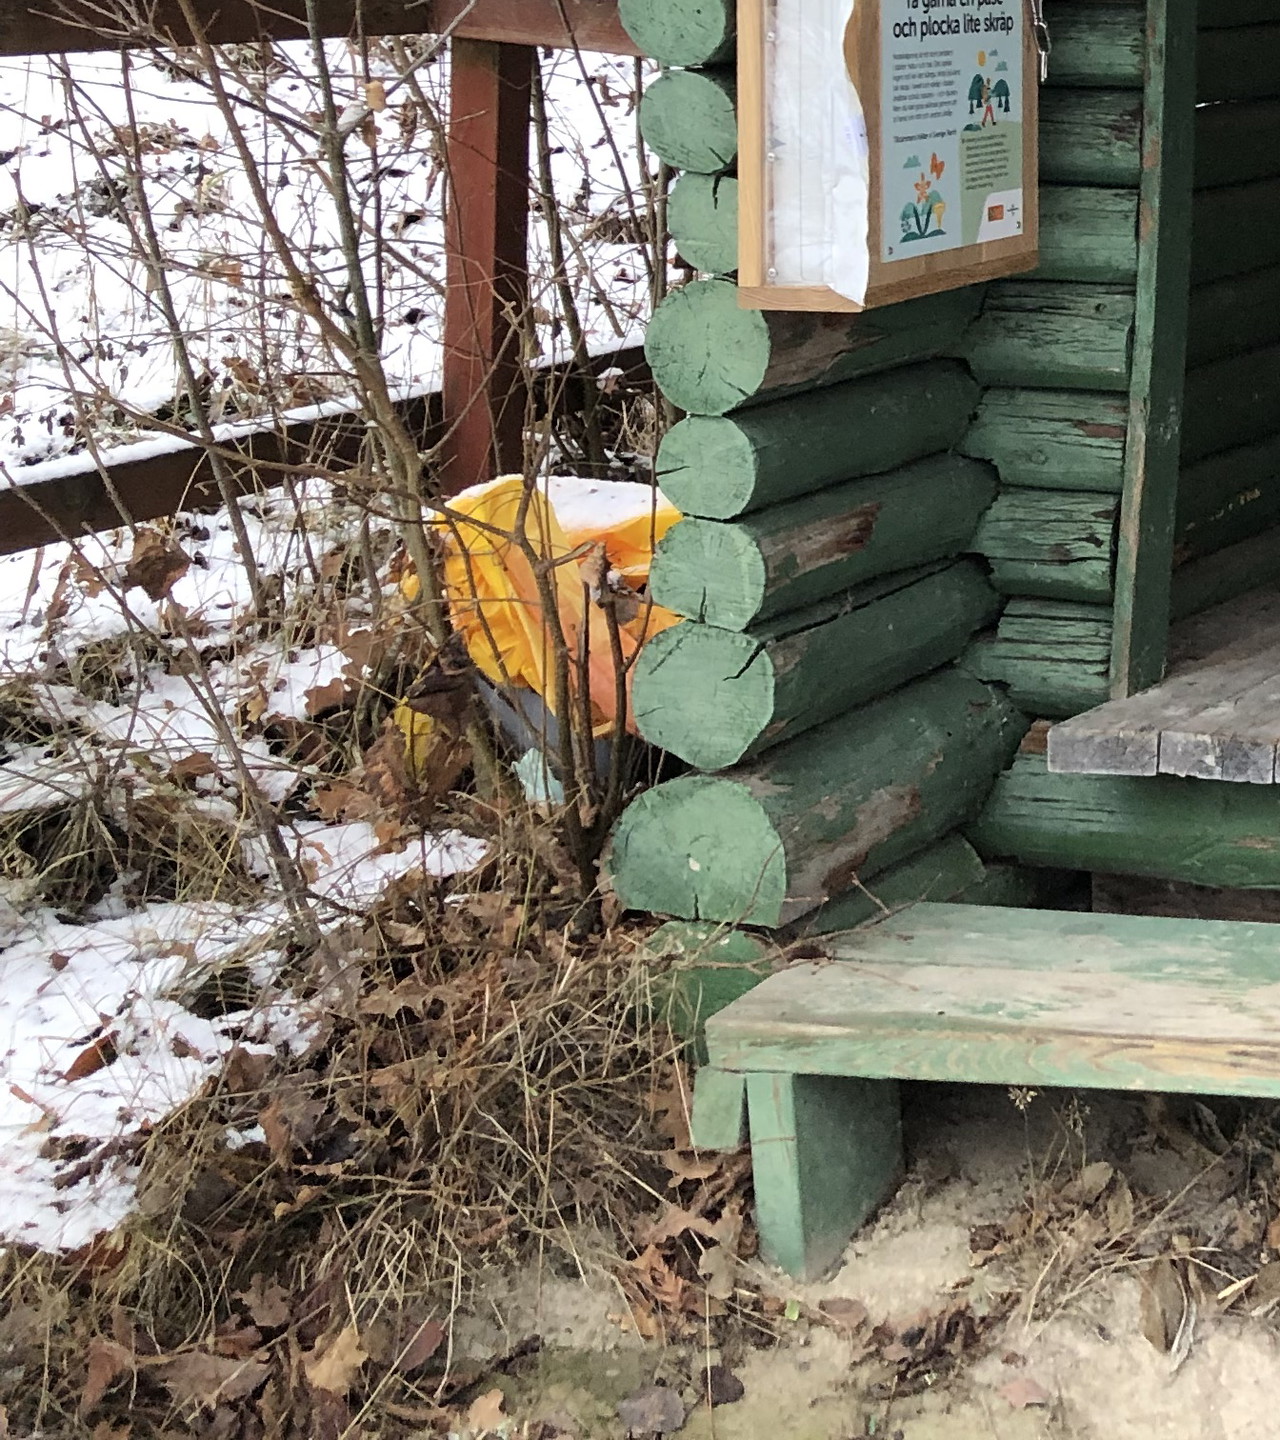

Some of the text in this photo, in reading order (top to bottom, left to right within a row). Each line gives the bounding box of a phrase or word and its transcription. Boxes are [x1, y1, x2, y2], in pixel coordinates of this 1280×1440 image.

[893, 11, 1014, 42] och plocka lite skräp
